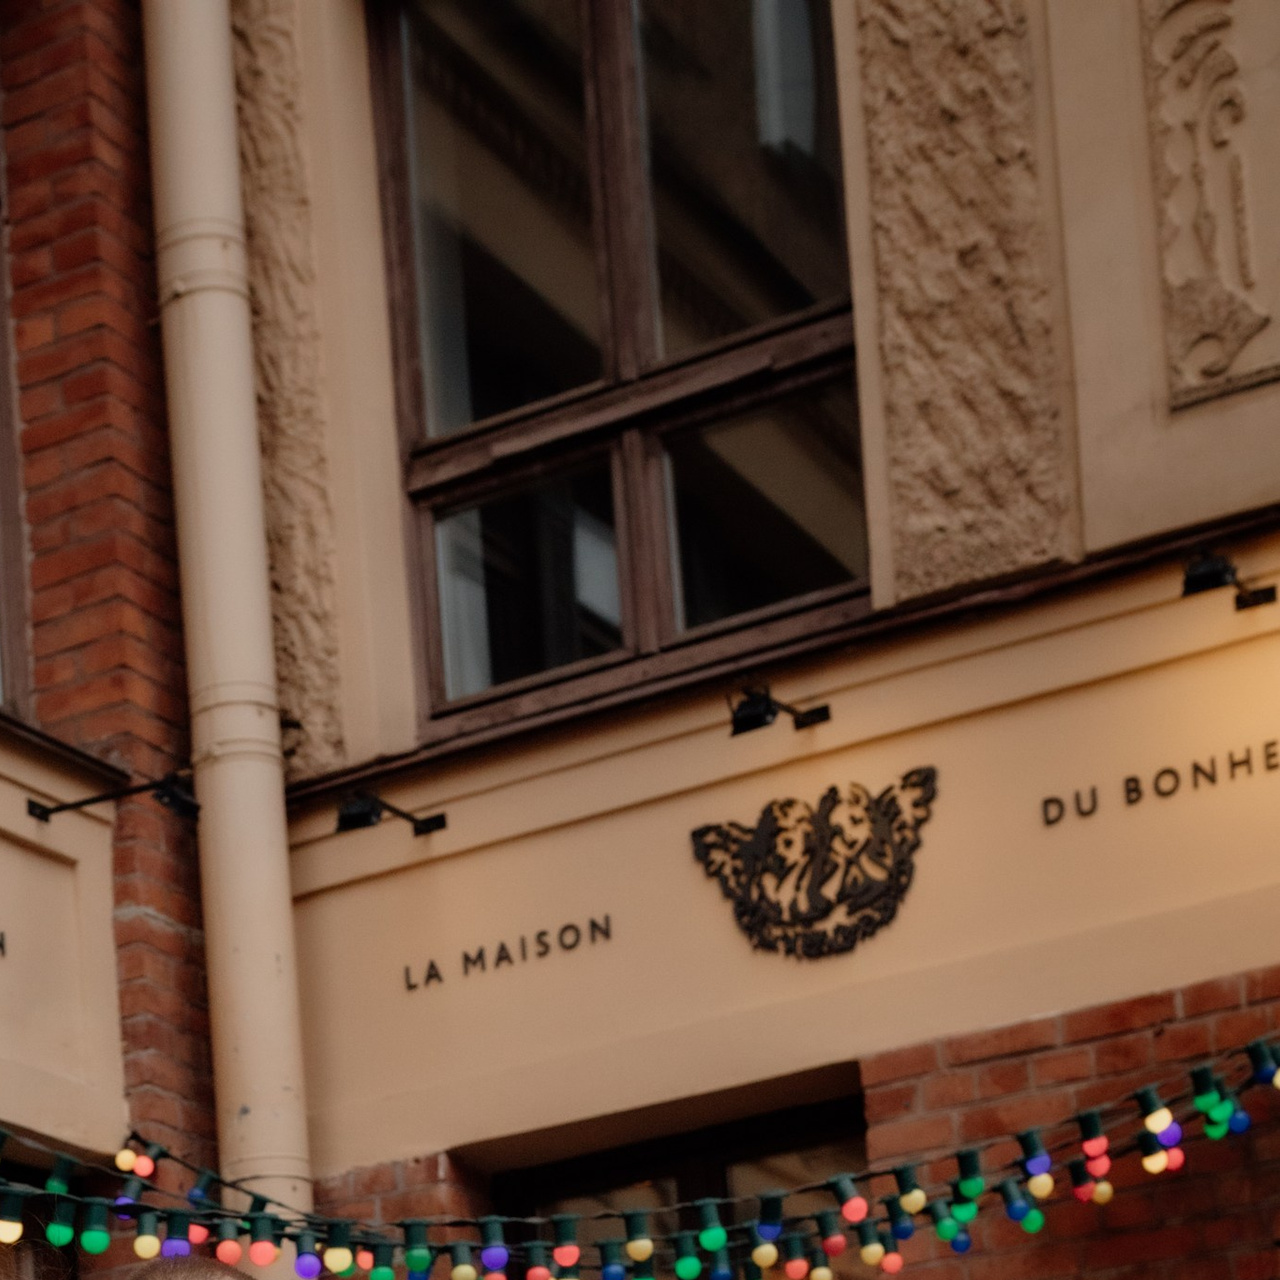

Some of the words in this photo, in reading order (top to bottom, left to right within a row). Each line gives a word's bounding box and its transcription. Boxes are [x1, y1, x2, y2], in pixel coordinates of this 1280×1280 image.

[405, 959, 444, 991] LA
[462, 914, 612, 976] MAISON
[1042, 785, 1098, 827] DU
[1124, 740, 1280, 807] BONHE
